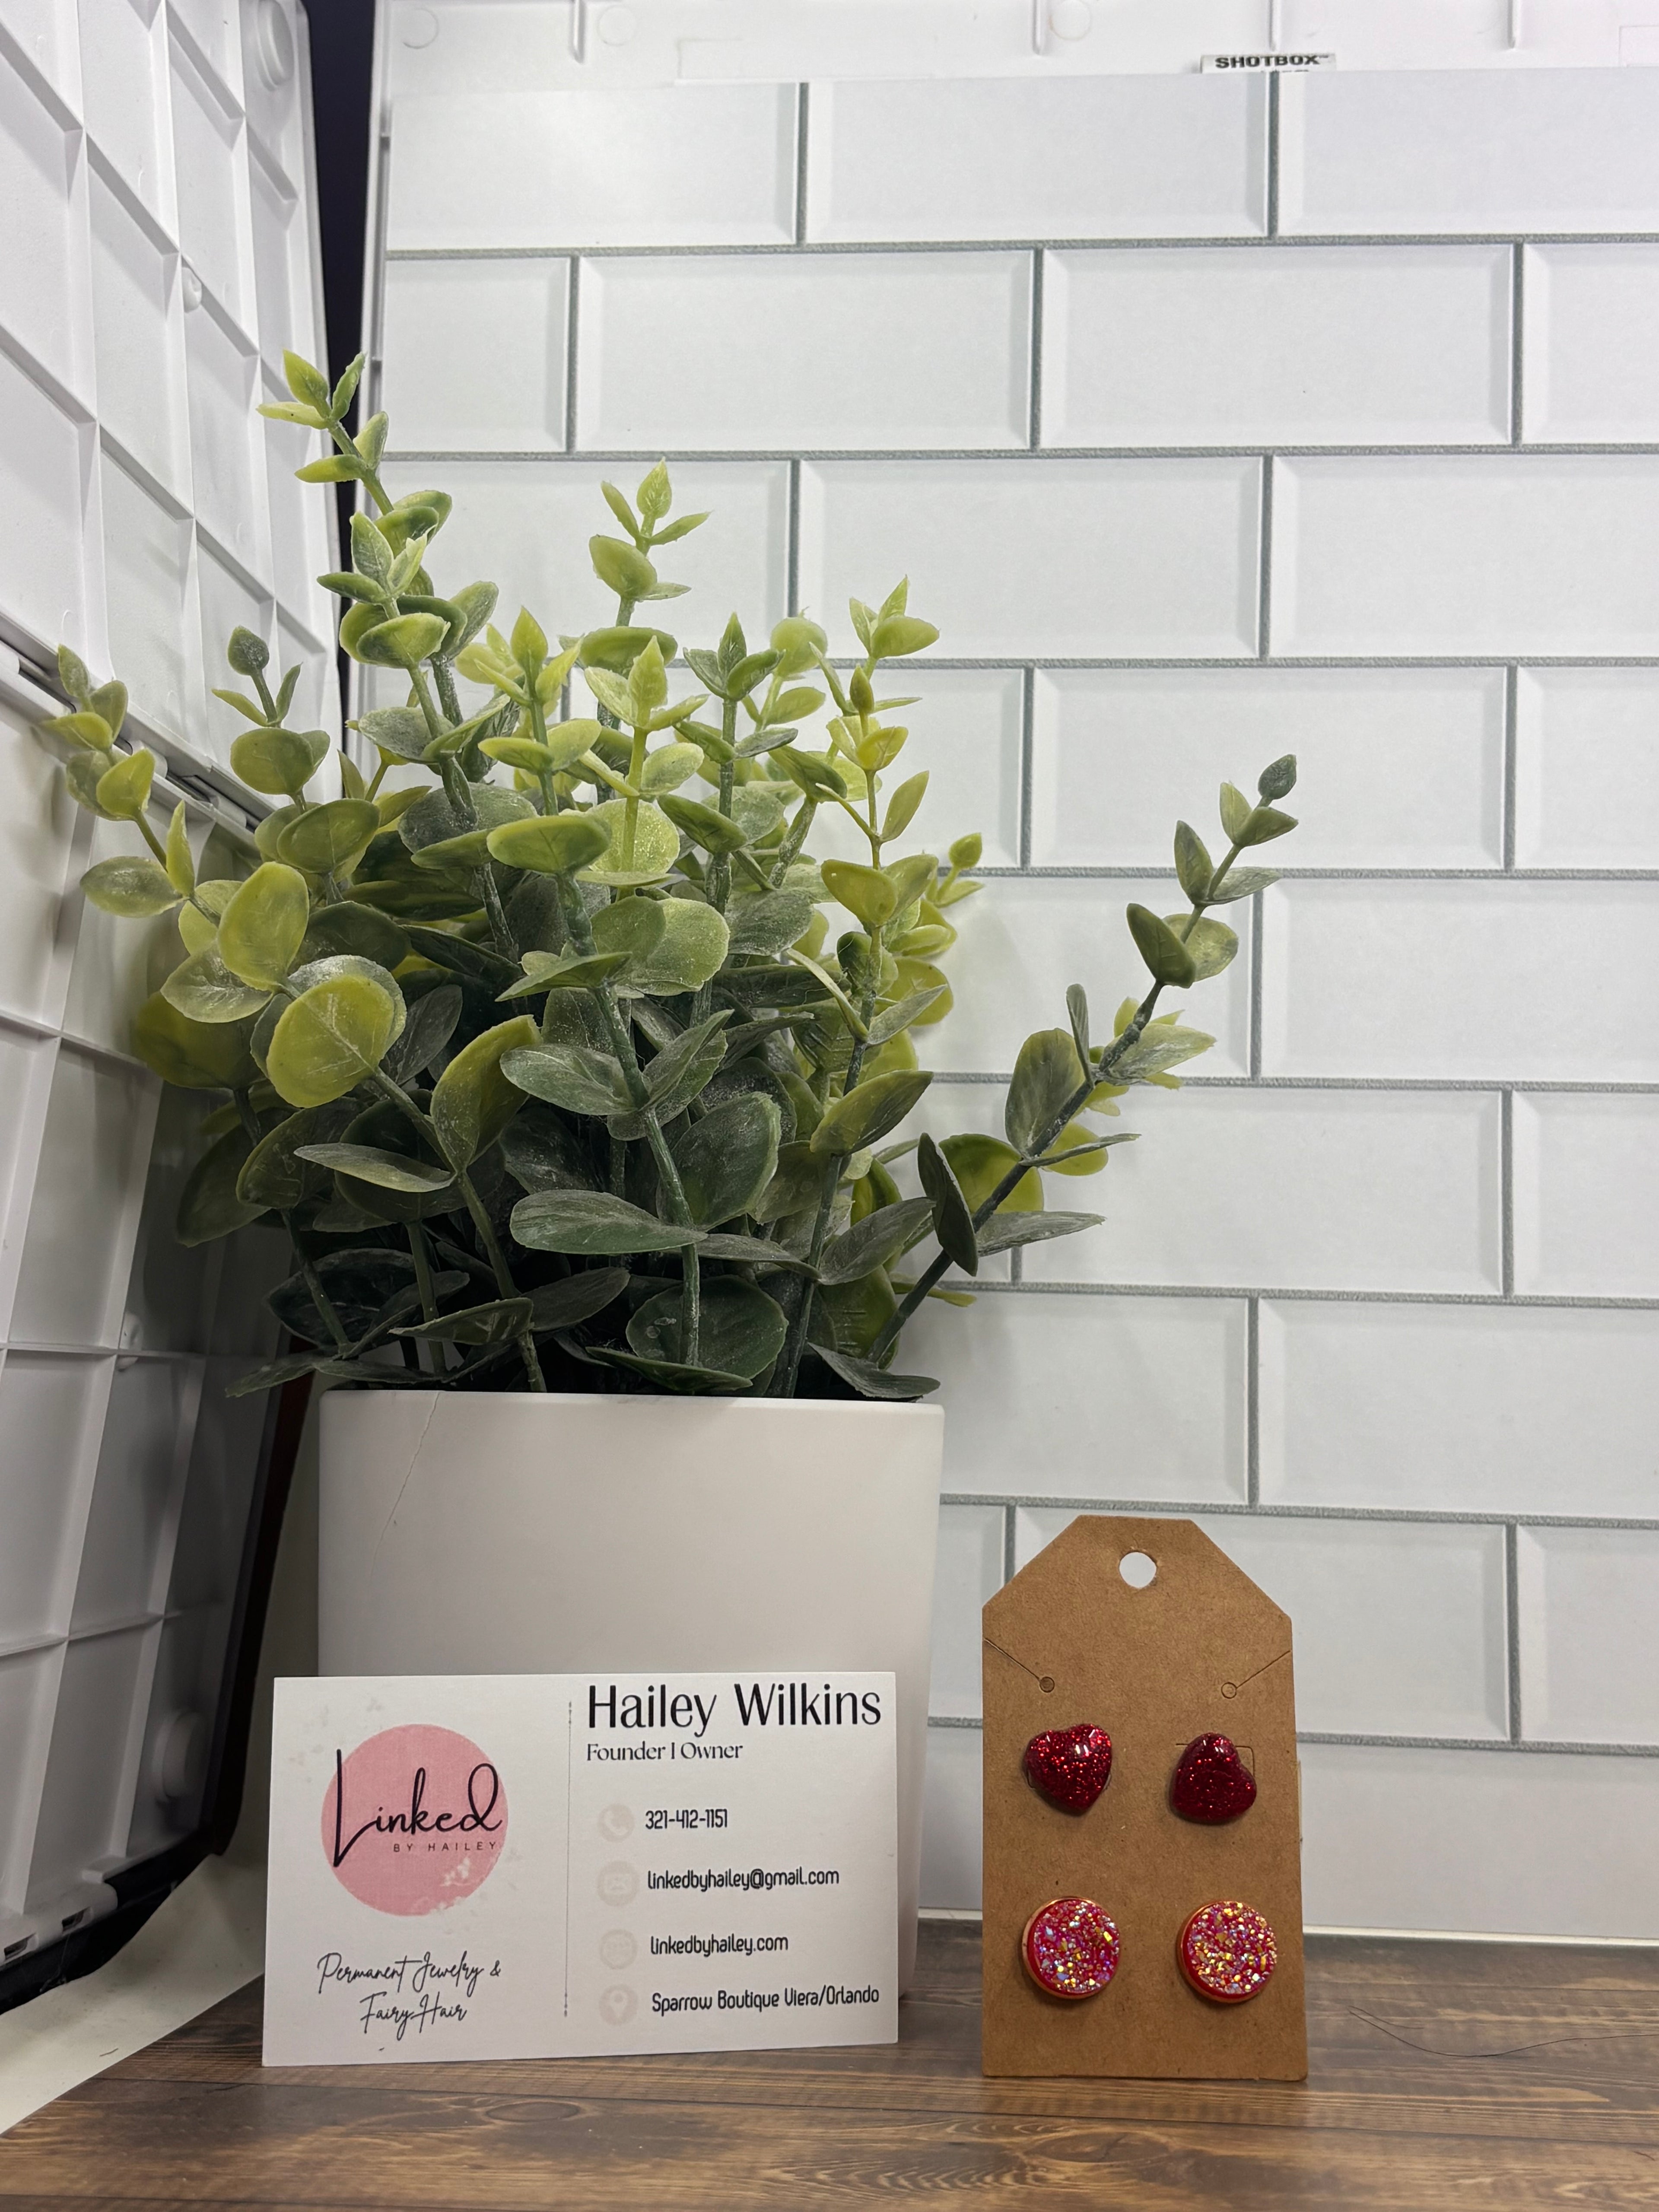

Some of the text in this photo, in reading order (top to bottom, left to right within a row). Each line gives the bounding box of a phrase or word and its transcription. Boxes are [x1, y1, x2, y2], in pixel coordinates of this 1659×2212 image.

[1215, 55, 1320, 69] SHOTBOX
[588, 1682, 881, 1738] Hailey Wilkins
[586, 1740, 667, 1761] Founder
[680, 1742, 744, 1760] Owner
[332, 1748, 503, 1869] Linked
[645, 1808, 728, 1830] 321-412-1151
[393, 1841, 496, 1853] BY HAILEY
[647, 1866, 840, 1893] linkedbyhailey@gmail.com
[650, 1932, 789, 1958] linkedbyhailey.com
[316, 1950, 502, 1998] Permanent Jewelry &
[652, 1984, 880, 2018] Sparrow Boutique Viera/Orlando
[359, 1990, 468, 2041] Fairy Hair
